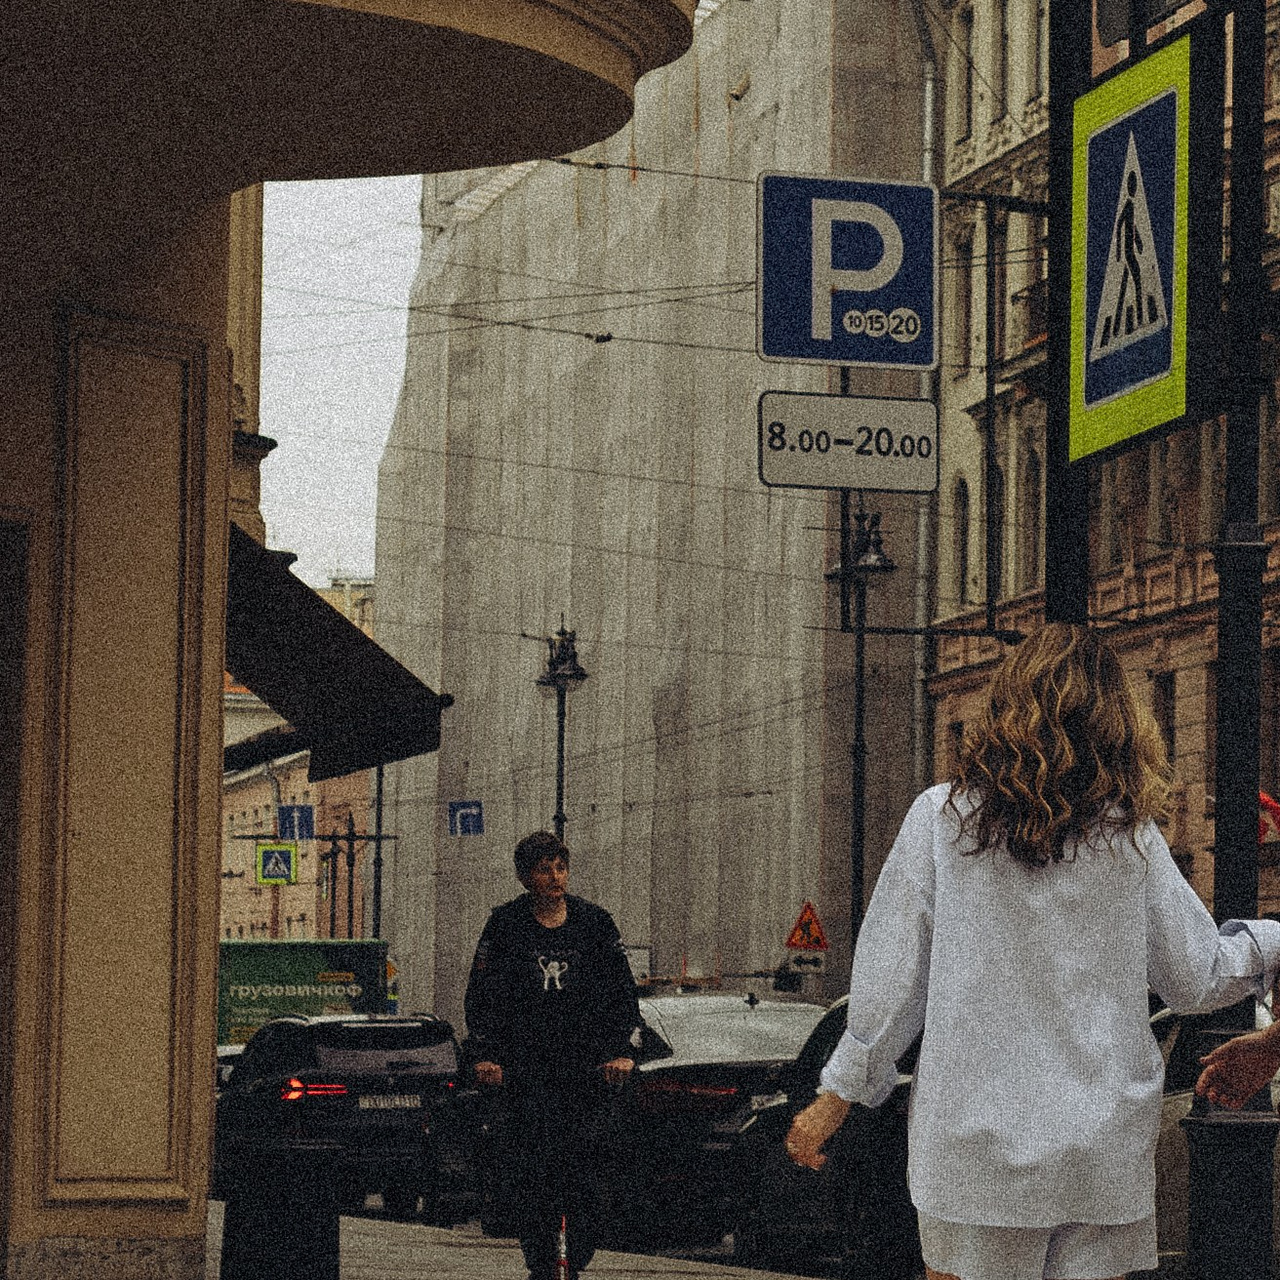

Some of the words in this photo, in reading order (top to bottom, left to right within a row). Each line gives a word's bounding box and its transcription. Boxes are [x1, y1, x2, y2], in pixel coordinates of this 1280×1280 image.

[811, 198, 904, 341] P
[847, 314, 863, 329] 10
[867, 314, 885, 332] 15
[891, 314, 918, 336] 20
